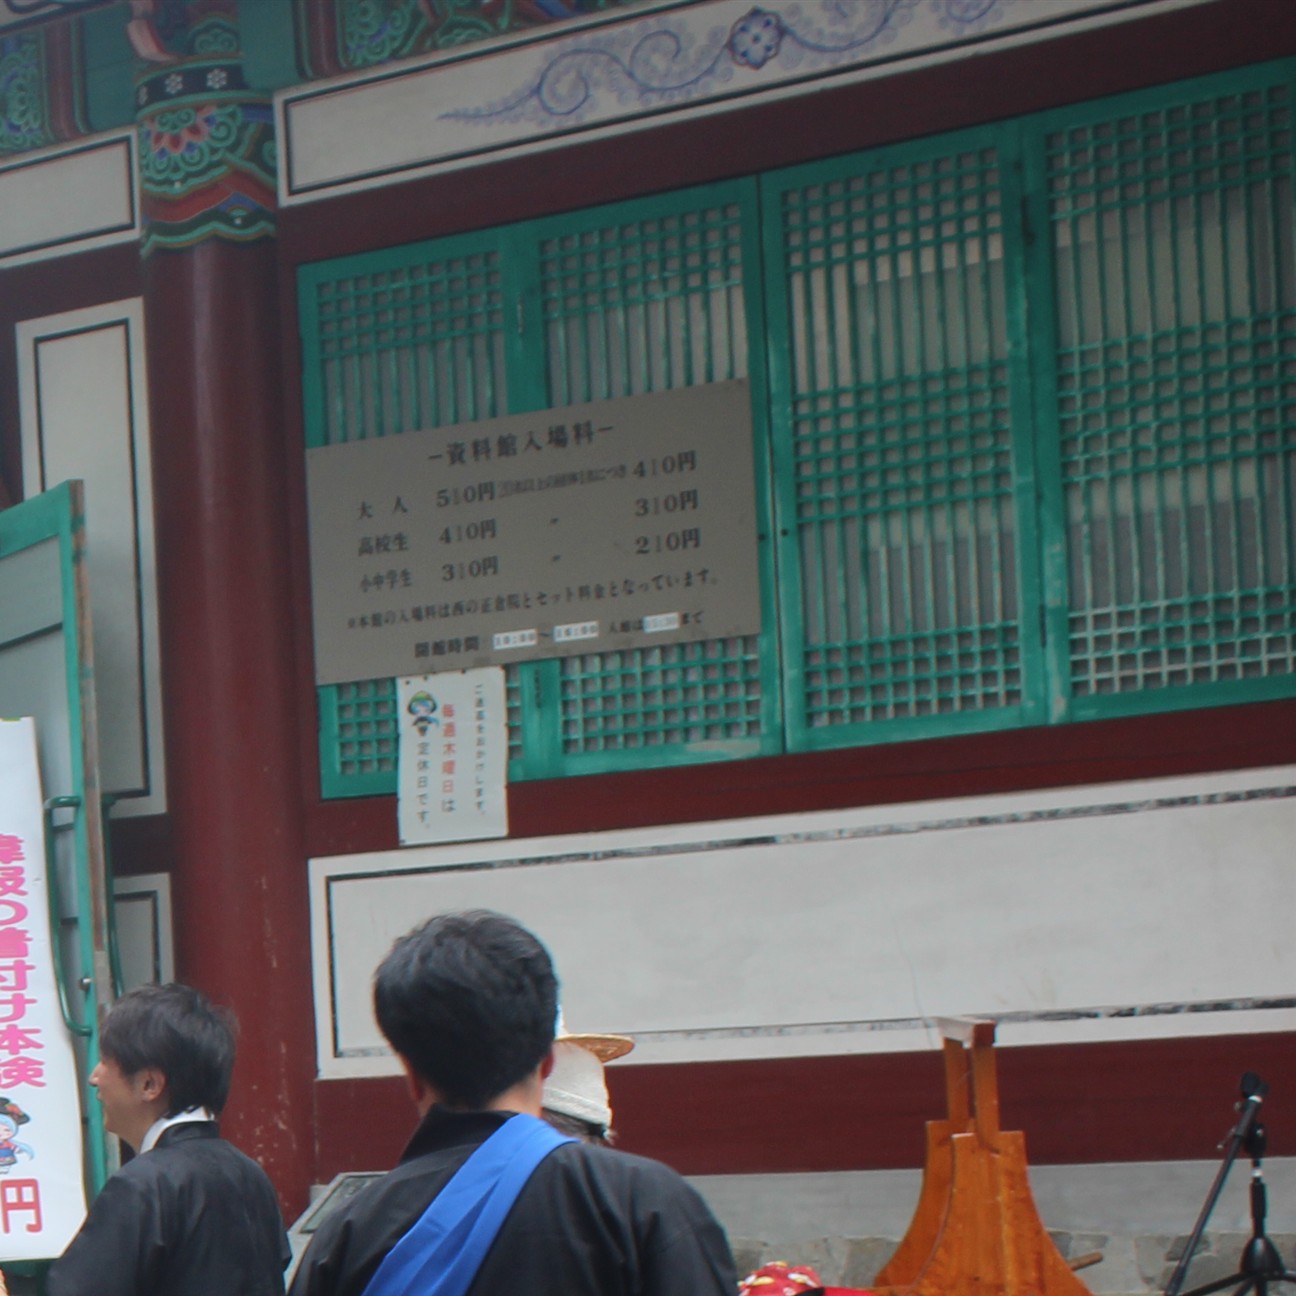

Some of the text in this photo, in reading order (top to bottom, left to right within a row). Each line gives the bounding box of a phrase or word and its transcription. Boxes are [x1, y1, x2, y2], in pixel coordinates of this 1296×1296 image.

[436, 481, 495, 508] 510円
[633, 450, 696, 479] 410円
[358, 532, 408, 557] 高校生
[439, 518, 496, 545] 410円
[635, 489, 698, 517] 310円
[442, 555, 499, 582] 310円
[635, 528, 701, 554] 210円
[442, 703, 456, 812] 毎週木曜日は
